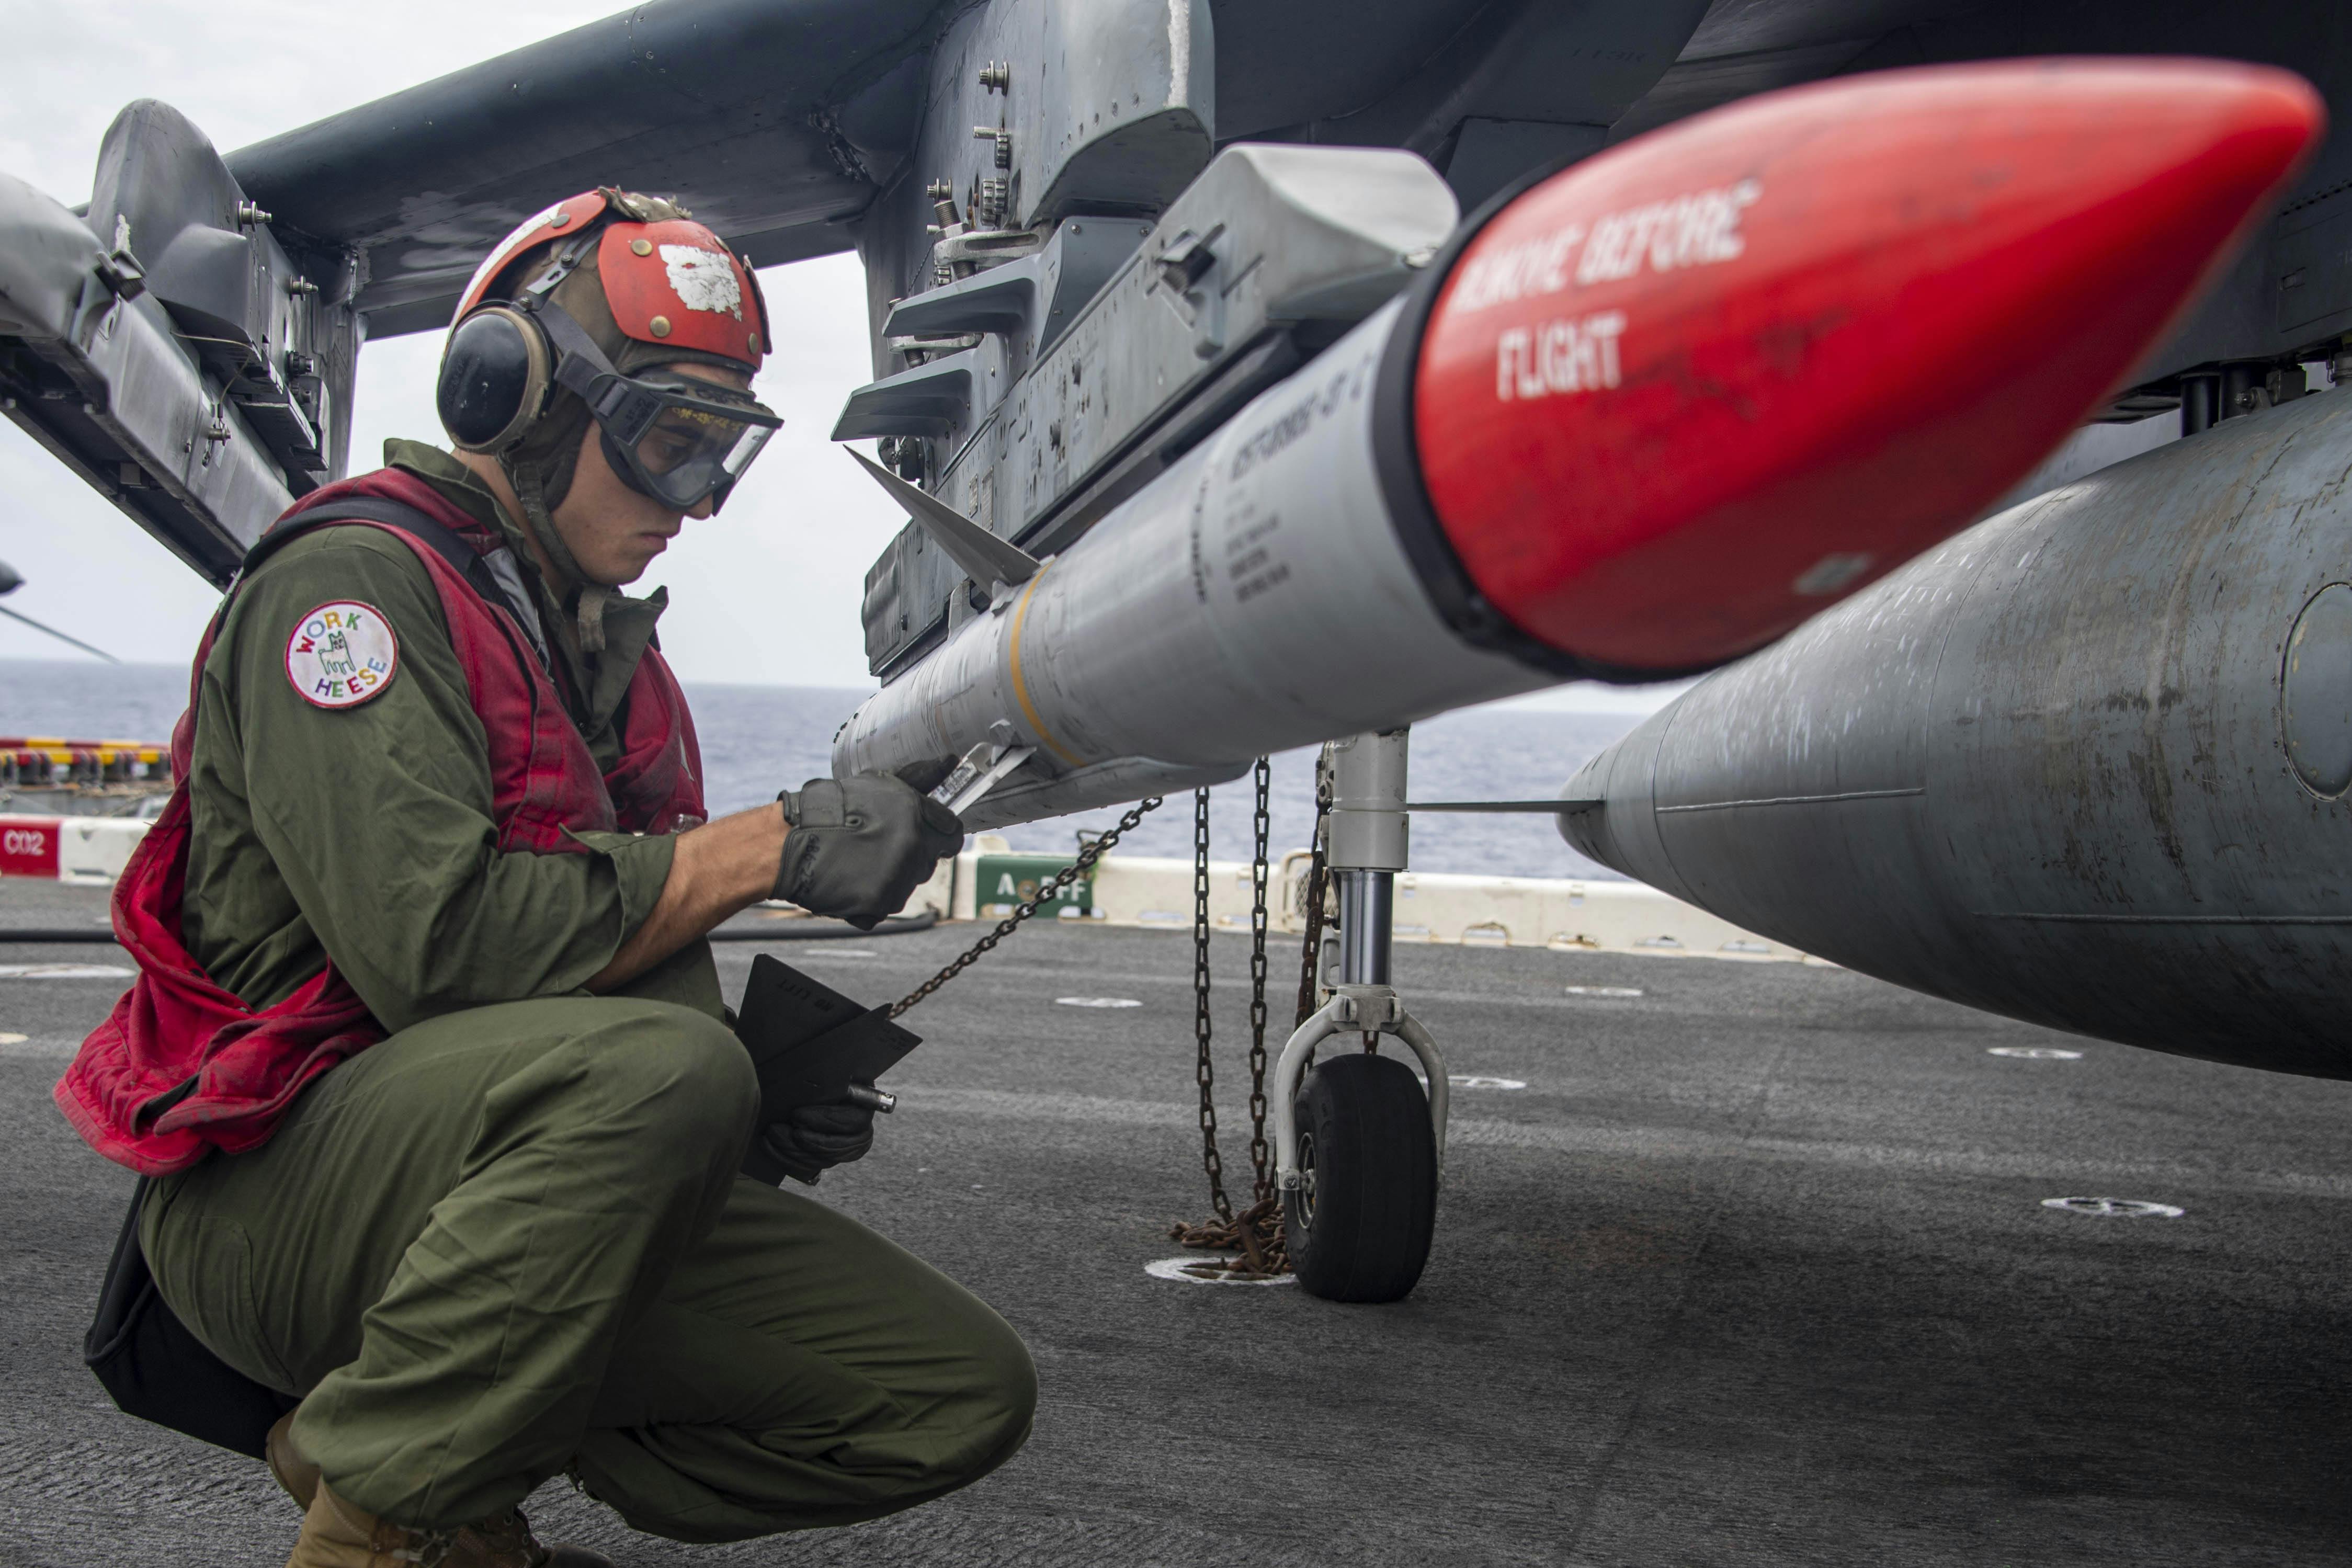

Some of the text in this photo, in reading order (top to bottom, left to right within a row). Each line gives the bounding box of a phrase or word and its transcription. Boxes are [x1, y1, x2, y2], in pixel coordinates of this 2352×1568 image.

[1496, 310, 1626, 402] FLIGHT
[296, 611, 362, 653] WORK
[315, 657, 388, 698] HEESE
